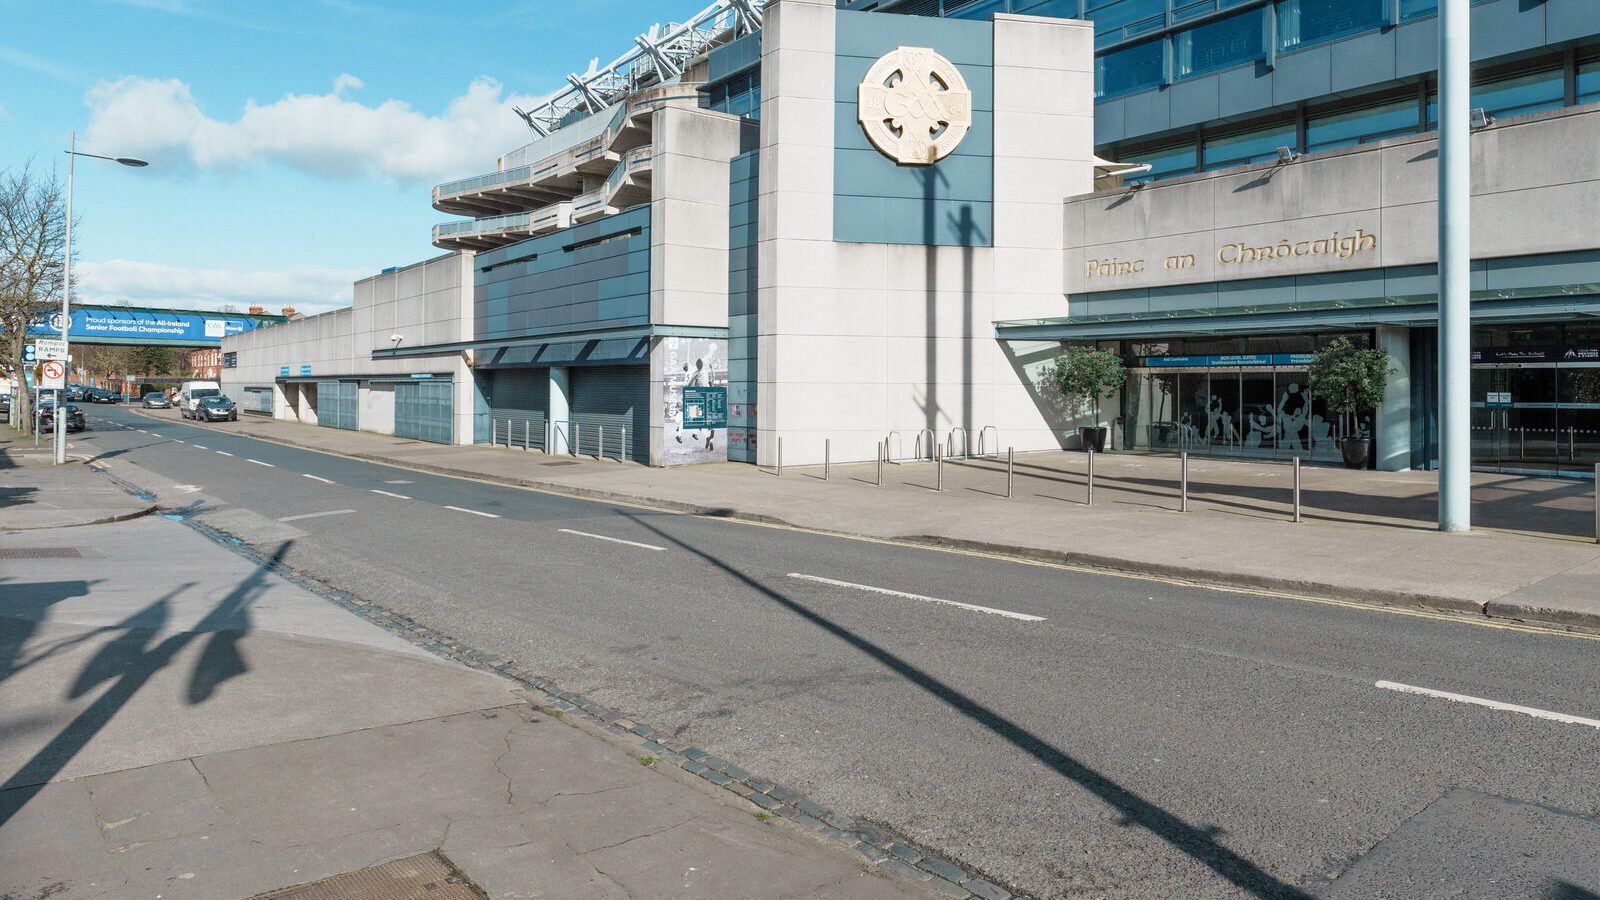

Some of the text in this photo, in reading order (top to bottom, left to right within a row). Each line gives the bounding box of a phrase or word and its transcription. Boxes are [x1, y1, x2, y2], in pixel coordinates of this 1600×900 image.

[1165, 254, 1195, 270] an
[156, 320, 190, 328] All-Ireland
[138, 326, 184, 335] Championship
